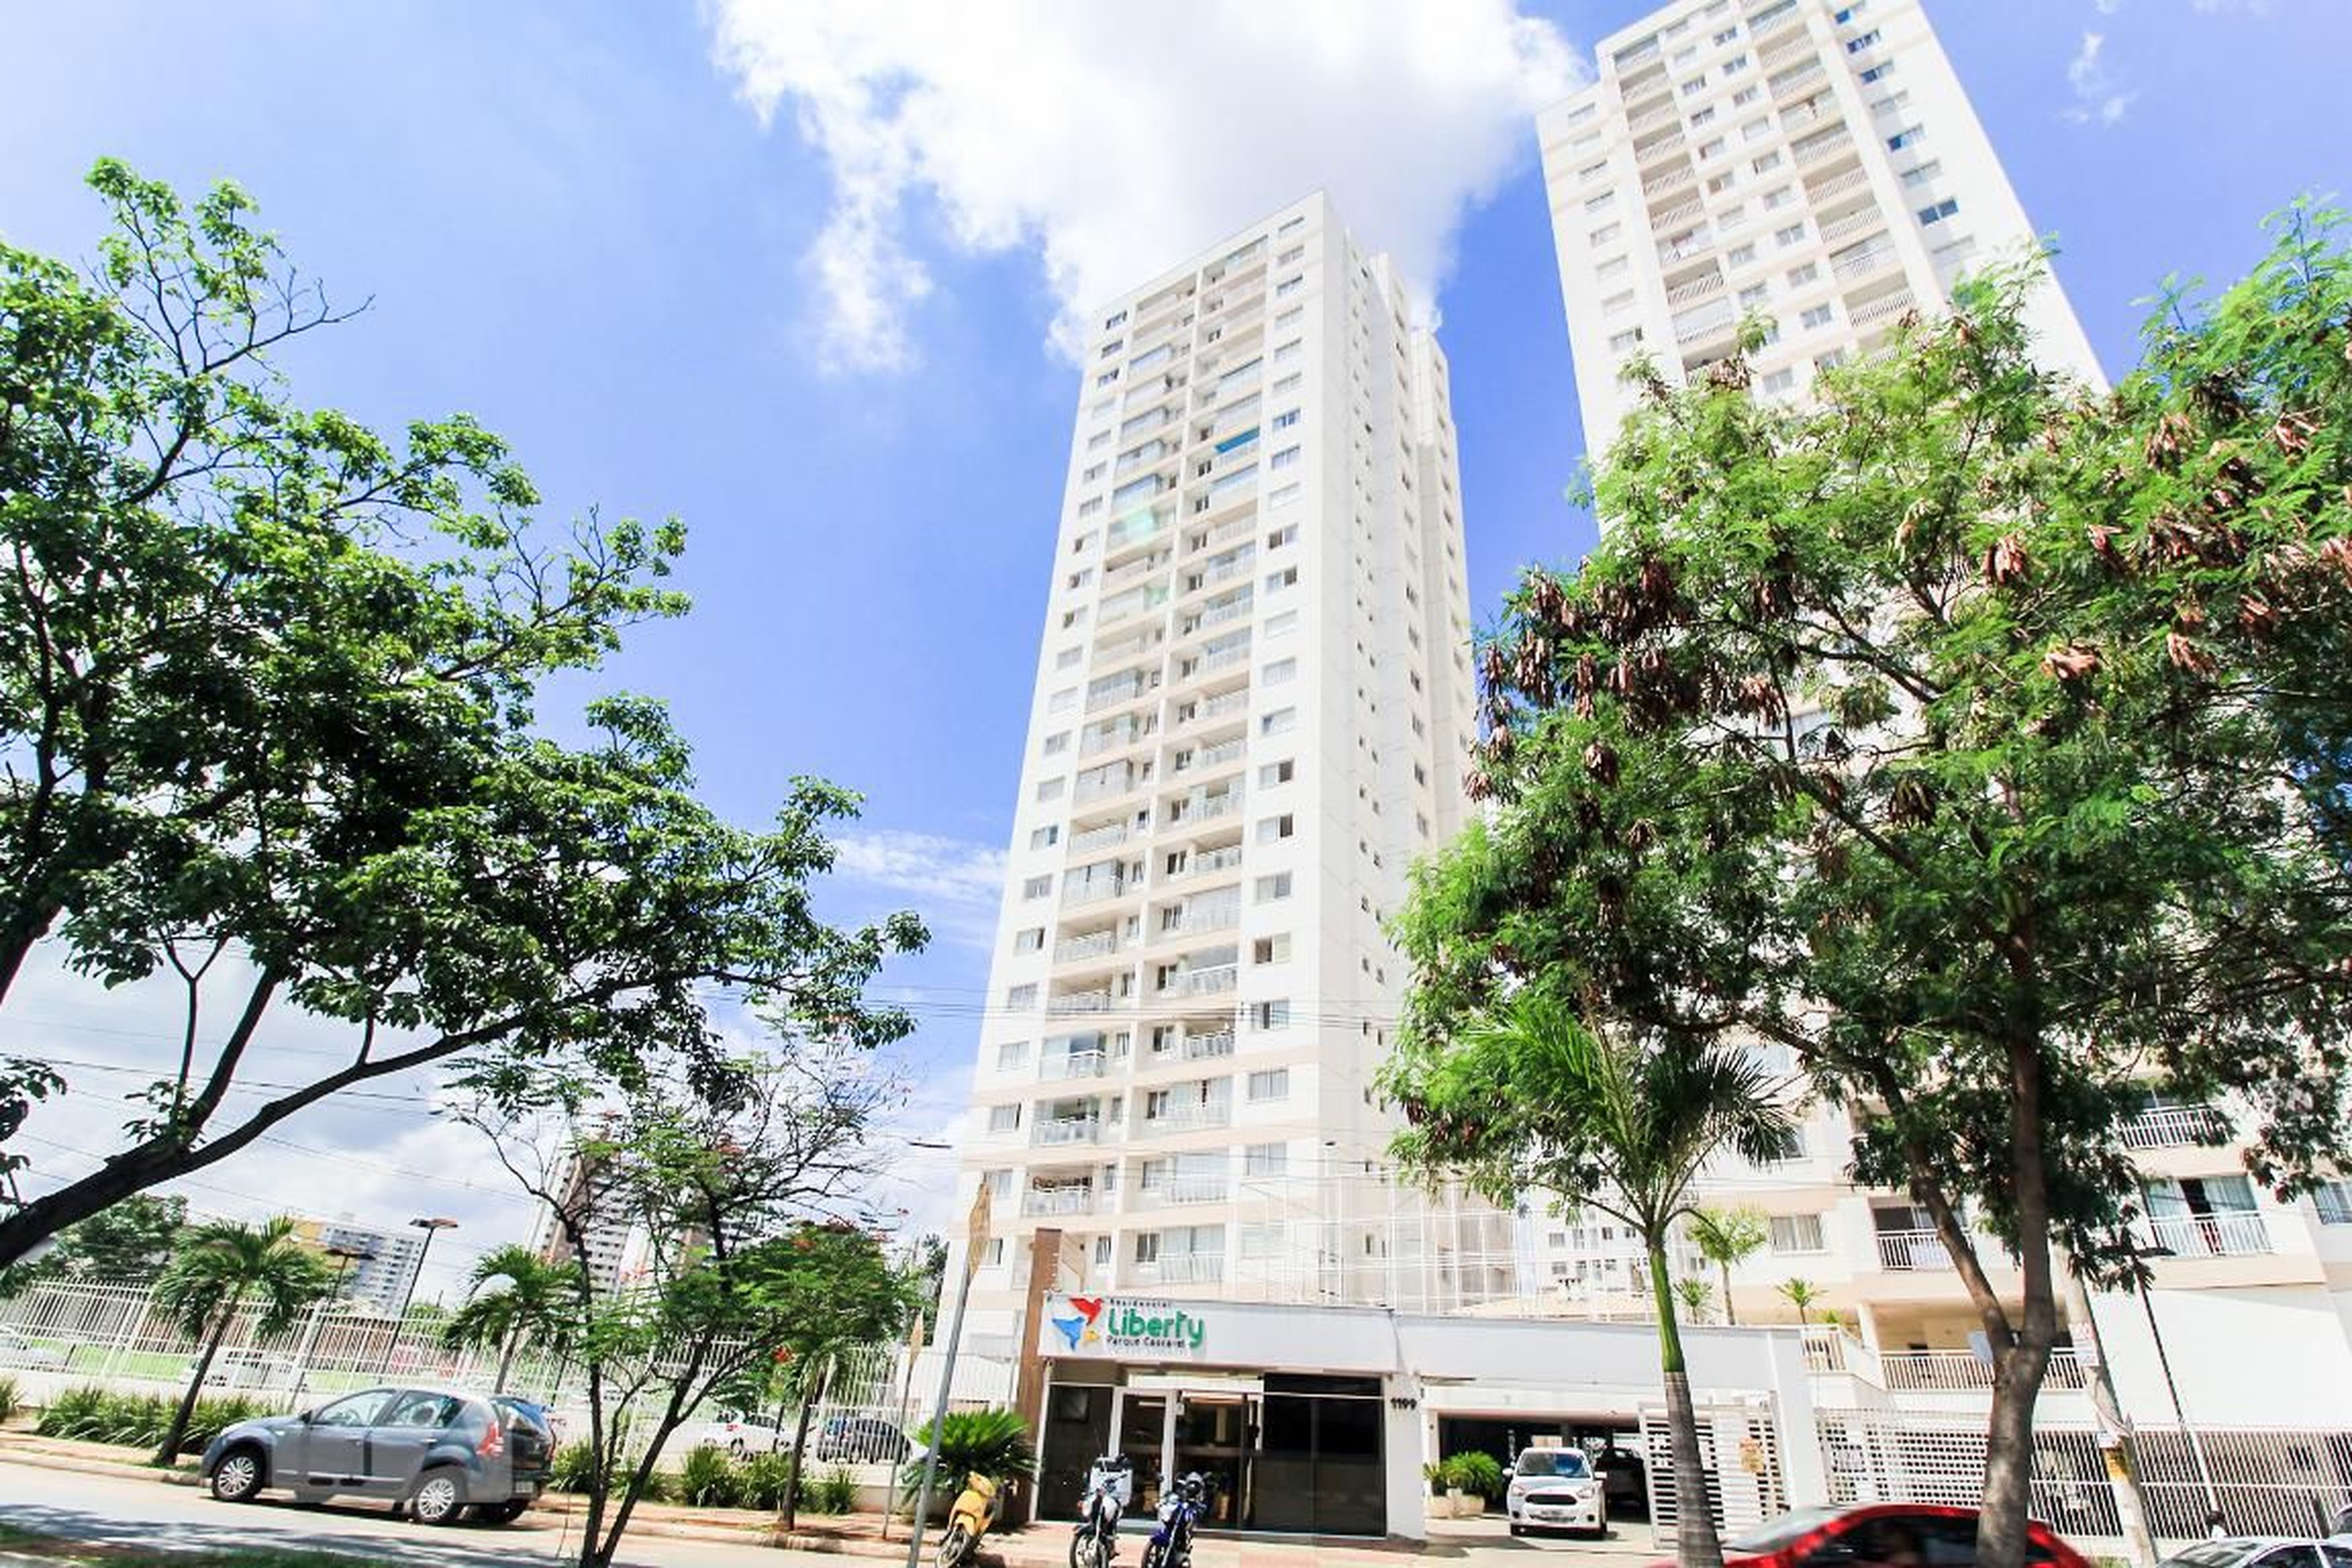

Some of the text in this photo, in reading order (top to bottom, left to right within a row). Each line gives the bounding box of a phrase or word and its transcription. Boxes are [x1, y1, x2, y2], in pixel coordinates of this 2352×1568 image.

[1108, 1308, 1204, 1348] Liberty
[1107, 1335, 1140, 1346] Parque
[1390, 1397, 1417, 1410] 1199
